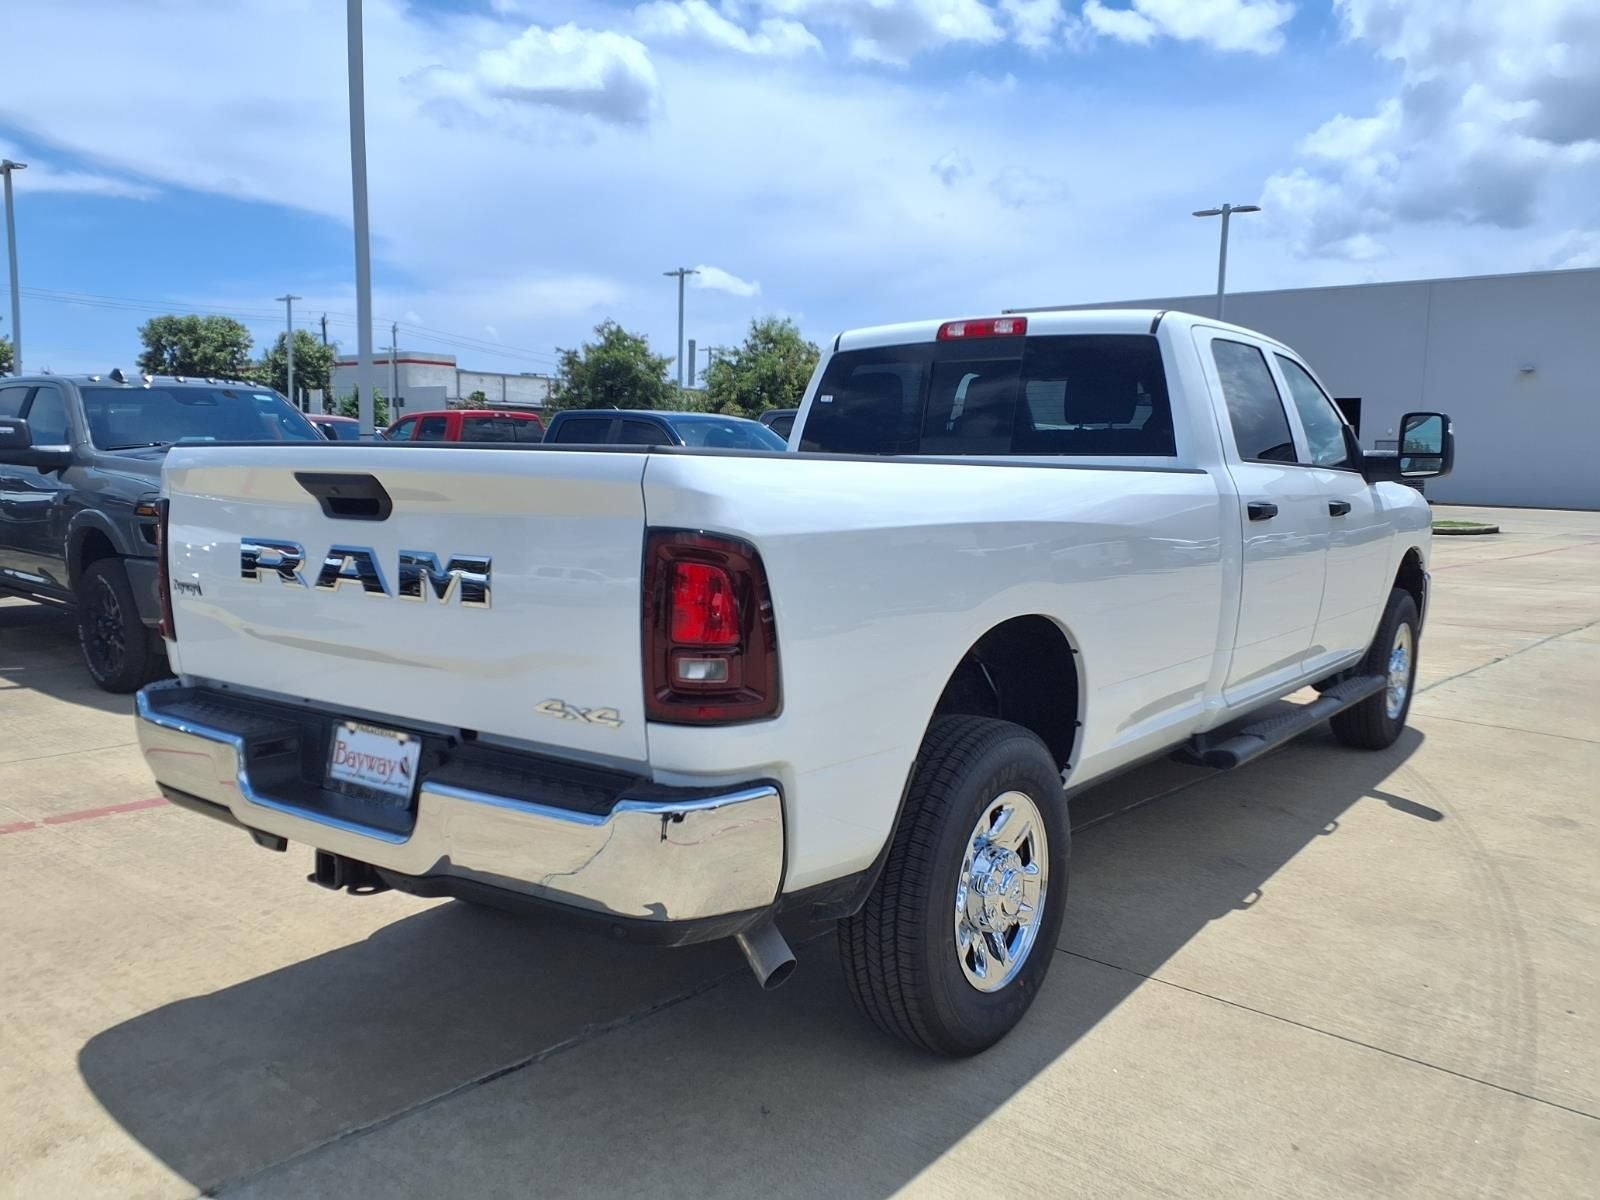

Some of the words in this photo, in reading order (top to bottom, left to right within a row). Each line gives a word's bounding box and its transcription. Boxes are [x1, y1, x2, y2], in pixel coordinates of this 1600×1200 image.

[240, 537, 493, 609] RAM
[533, 697, 625, 729] 4x4
[332, 740, 397, 784] Bayway
